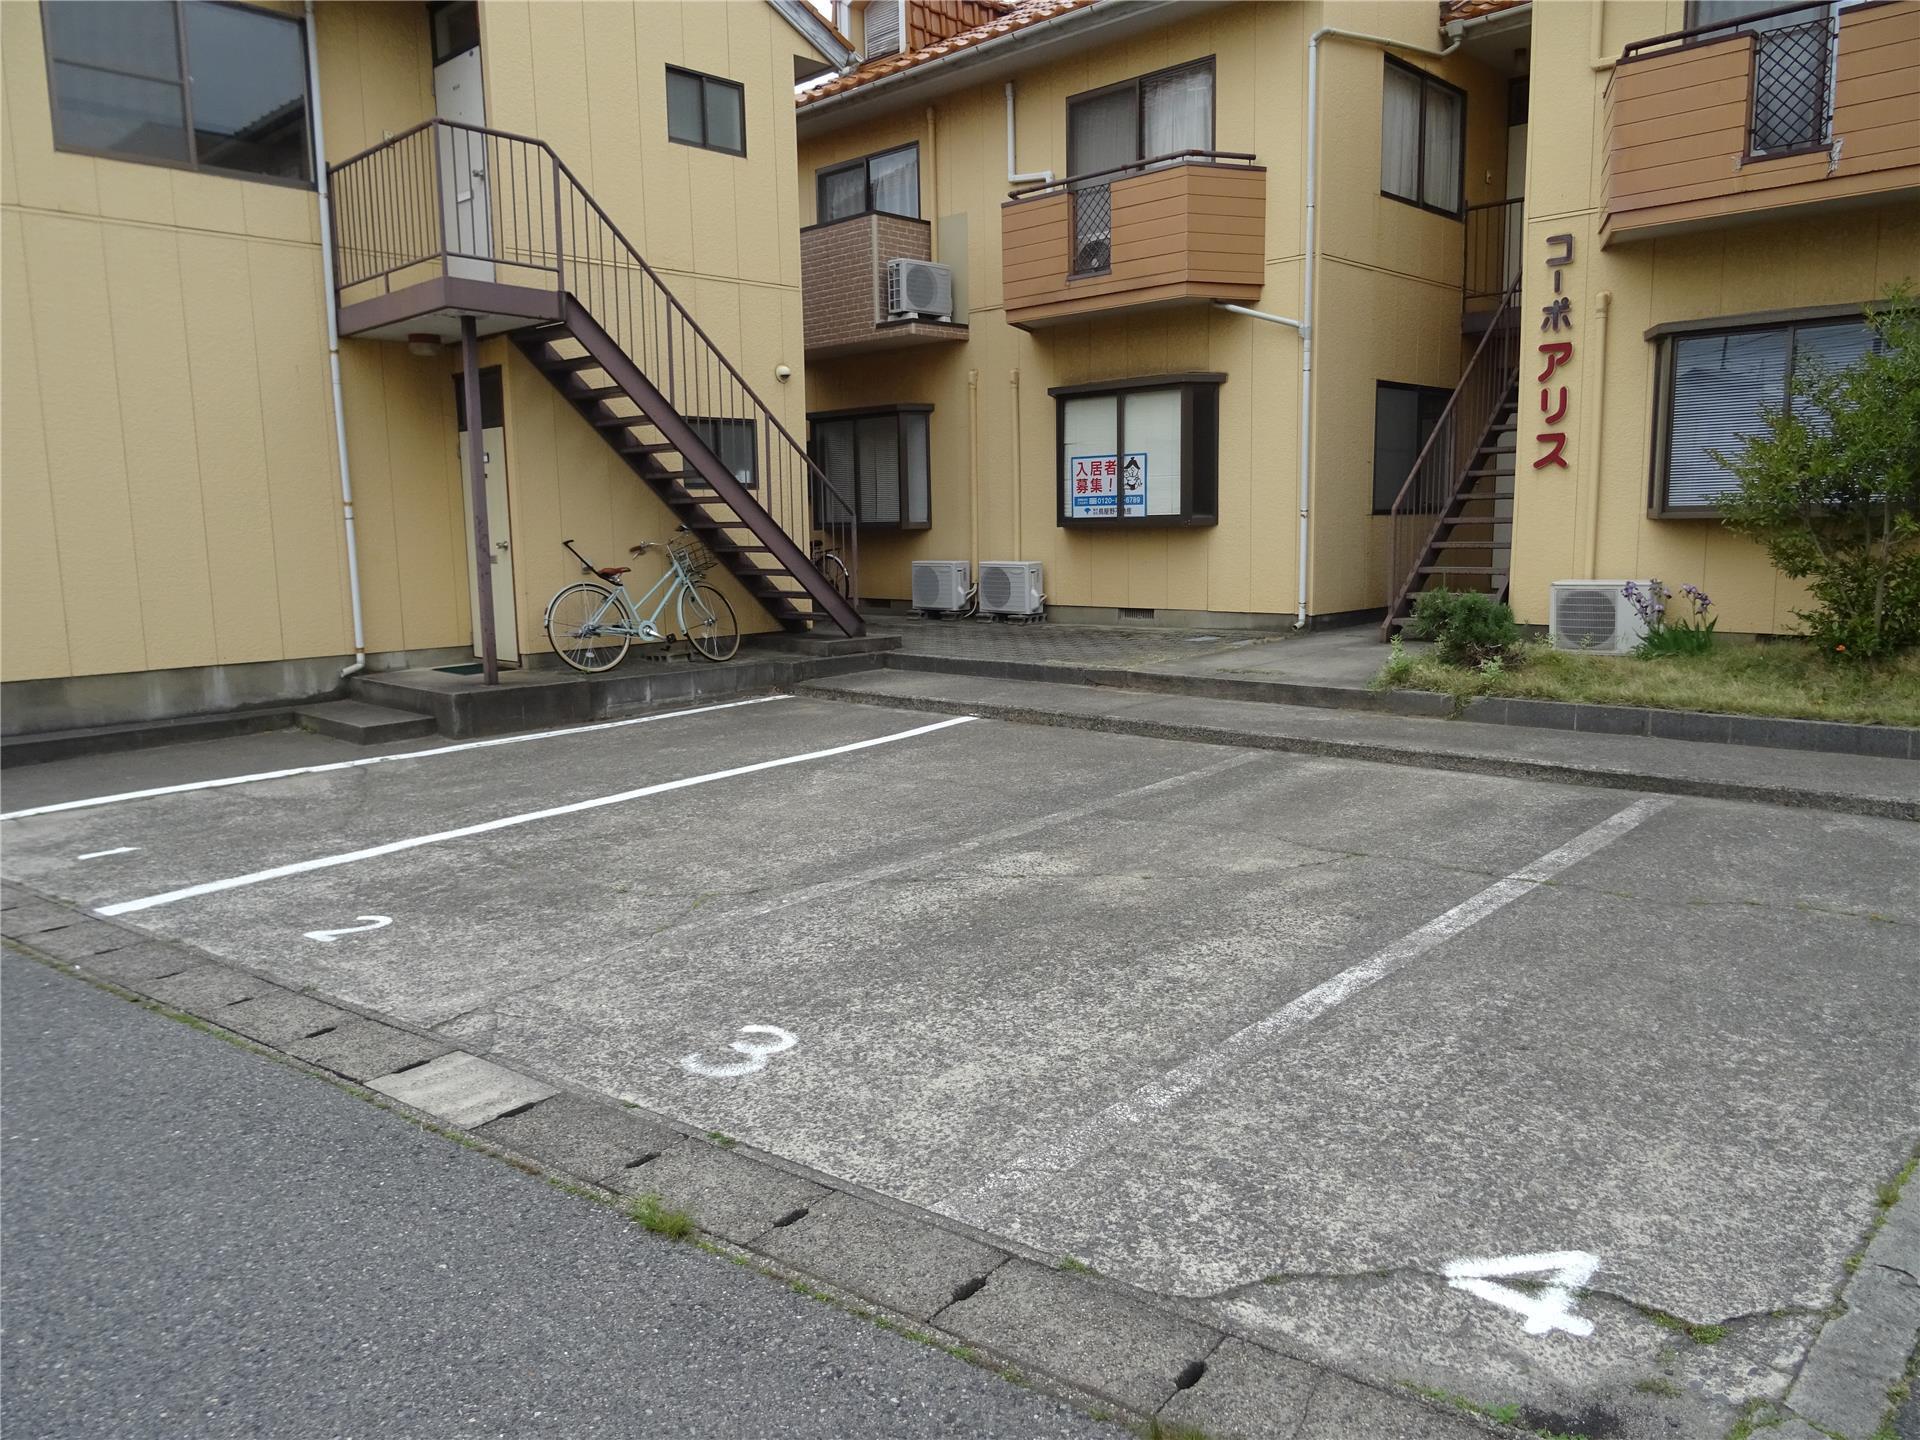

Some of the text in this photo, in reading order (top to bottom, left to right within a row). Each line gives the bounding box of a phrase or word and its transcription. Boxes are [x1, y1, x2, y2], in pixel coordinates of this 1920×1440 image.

[1533, 233, 1574, 469] コーポアリス
[1076, 460, 1117, 477] 入居者
[303, 915, 393, 943] 2
[679, 1024, 799, 1077] 3
[1441, 1250, 1600, 1337] 4
